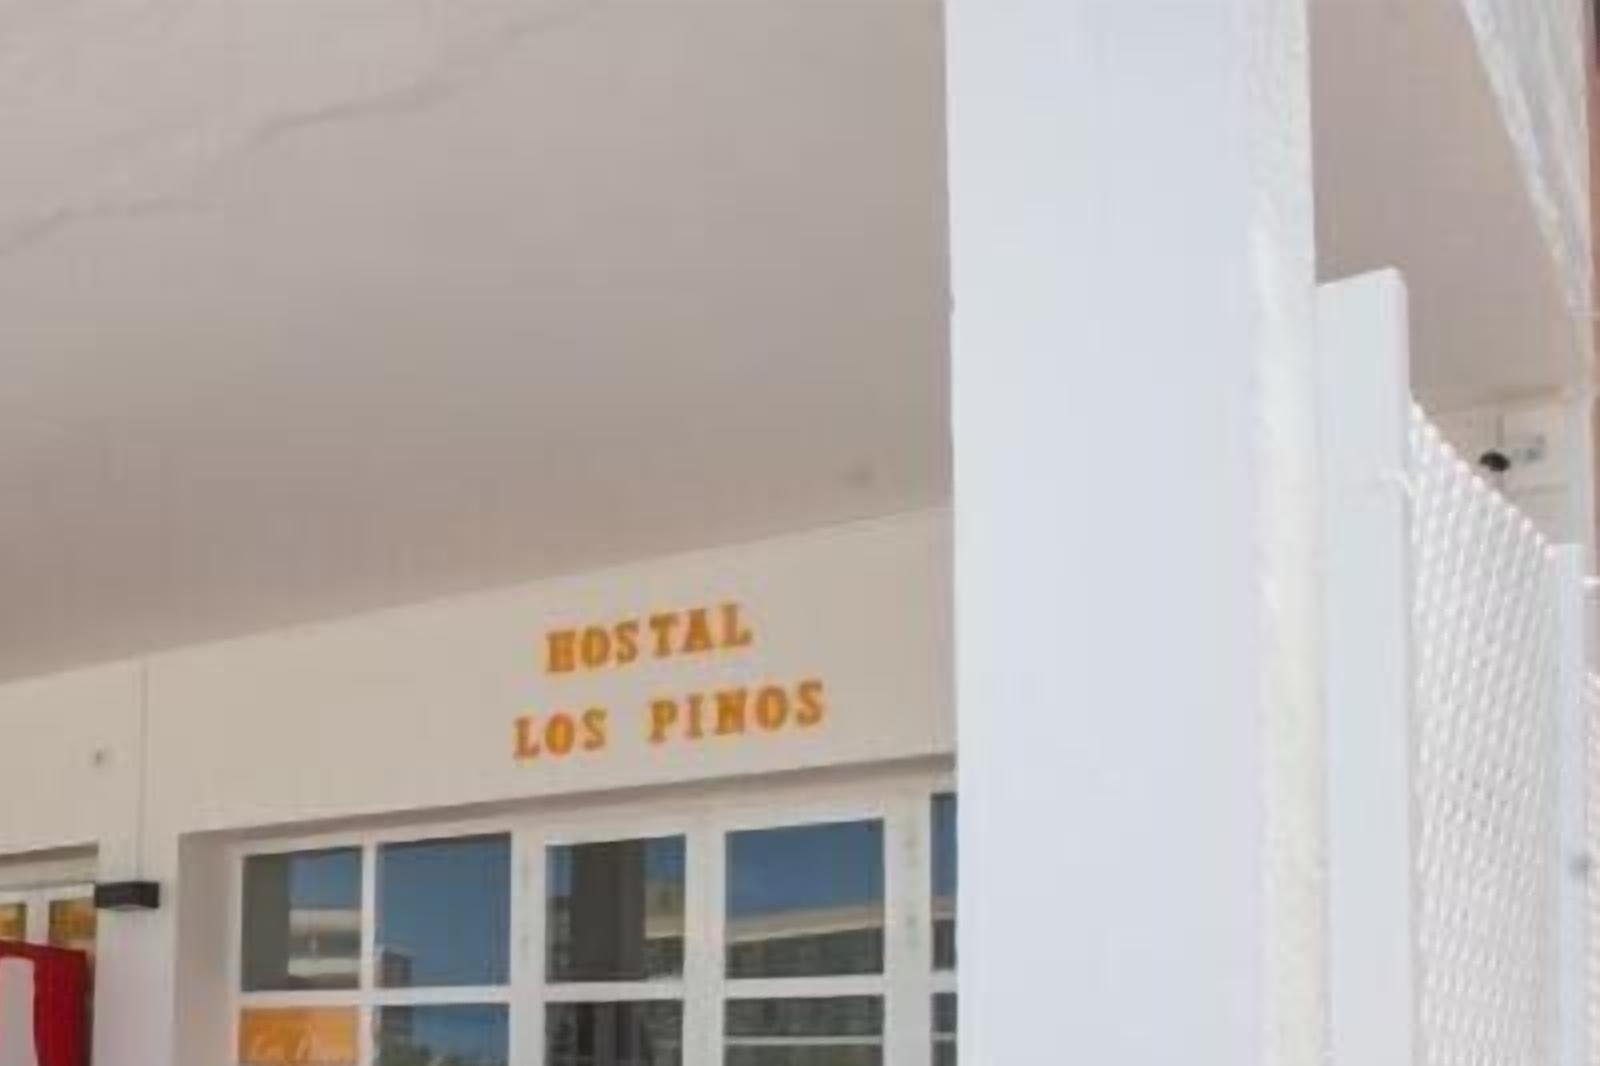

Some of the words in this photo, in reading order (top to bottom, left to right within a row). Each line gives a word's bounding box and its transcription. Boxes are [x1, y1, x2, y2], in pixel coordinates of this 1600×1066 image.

[545, 602, 753, 673] HOSTAL
[512, 707, 607, 760] LOS
[648, 679, 824, 743] PINOS
